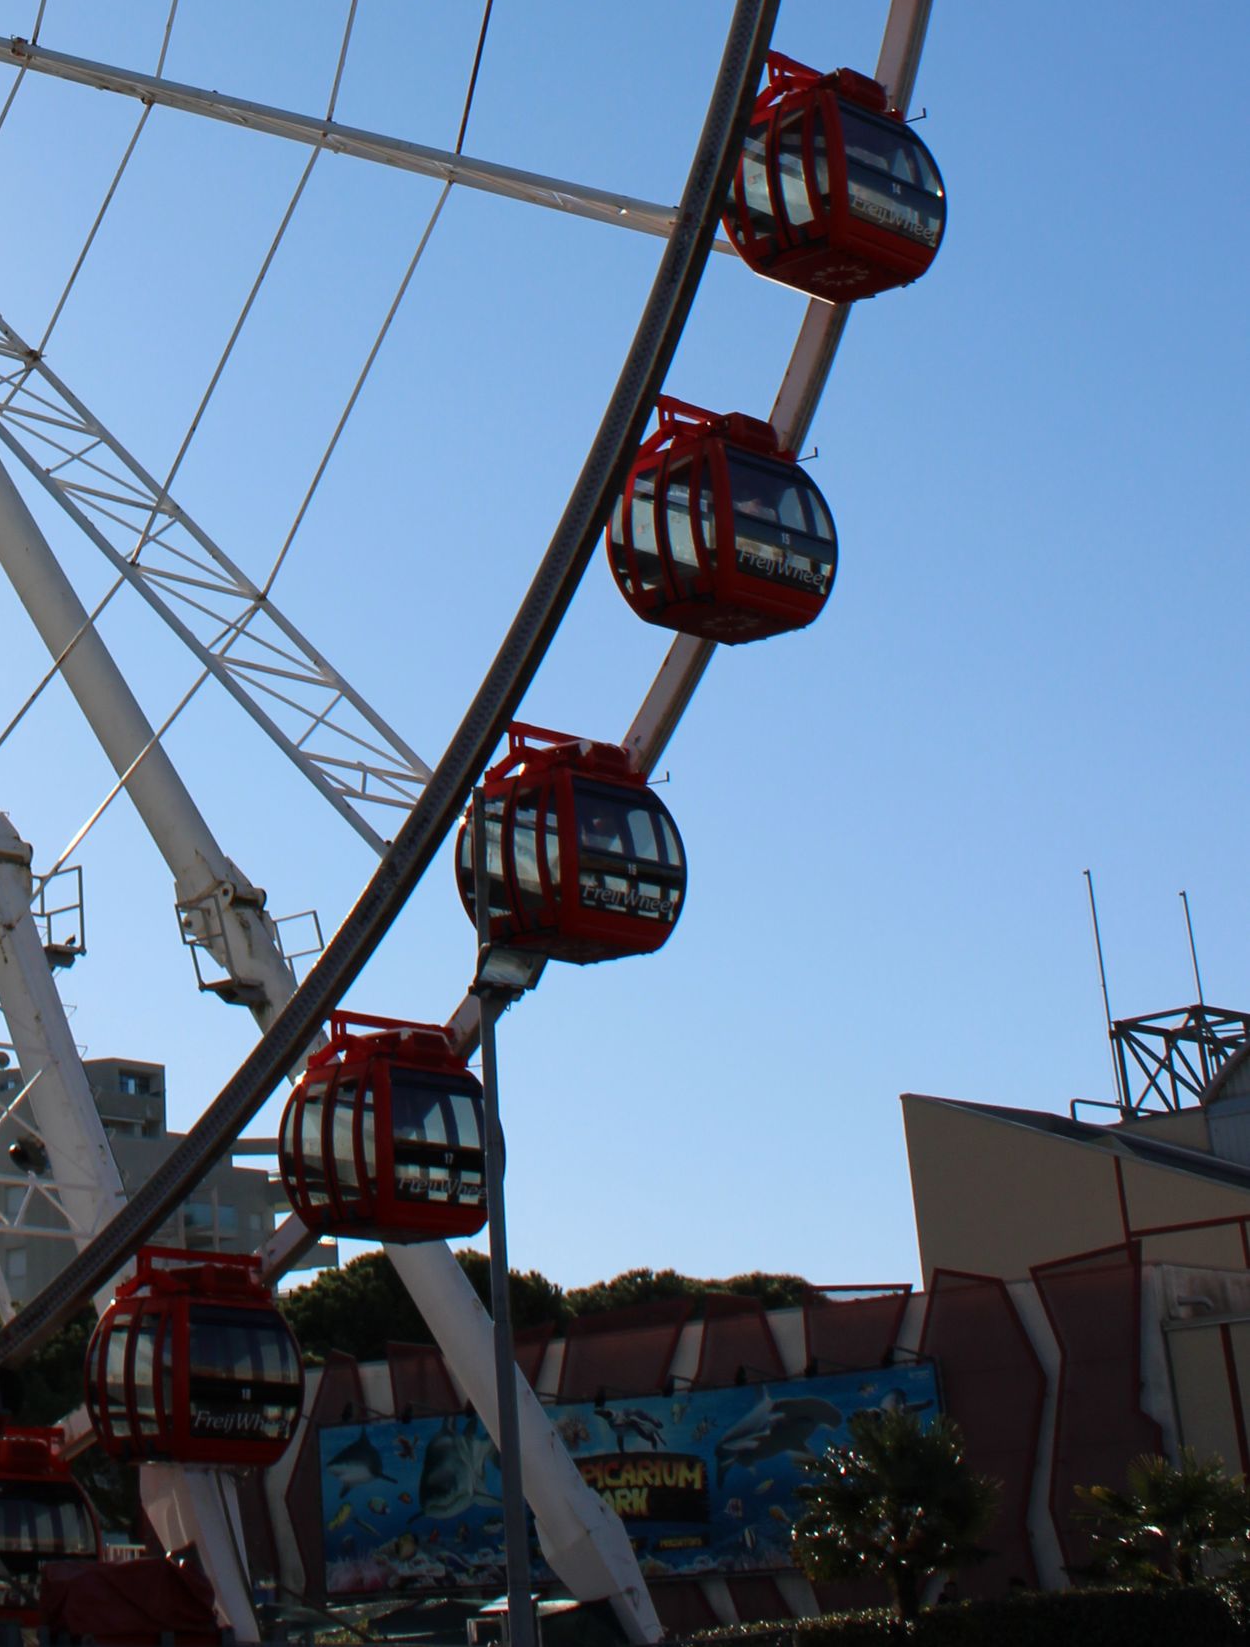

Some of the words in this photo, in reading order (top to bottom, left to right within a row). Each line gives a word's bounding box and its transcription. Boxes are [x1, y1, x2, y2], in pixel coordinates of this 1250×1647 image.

[892, 182, 901, 194] 14
[851, 198, 938, 241] FreijWheel
[781, 532, 790, 545] 15
[738, 551, 829, 587] FreijWheel
[582, 884, 675, 914] FreijWheel
[444, 1152, 453, 1164] 17
[398, 1177, 487, 1198] FreijWhee
[193, 1409, 293, 1433] FreijWheel
[600, 1487, 650, 1517] ARK
